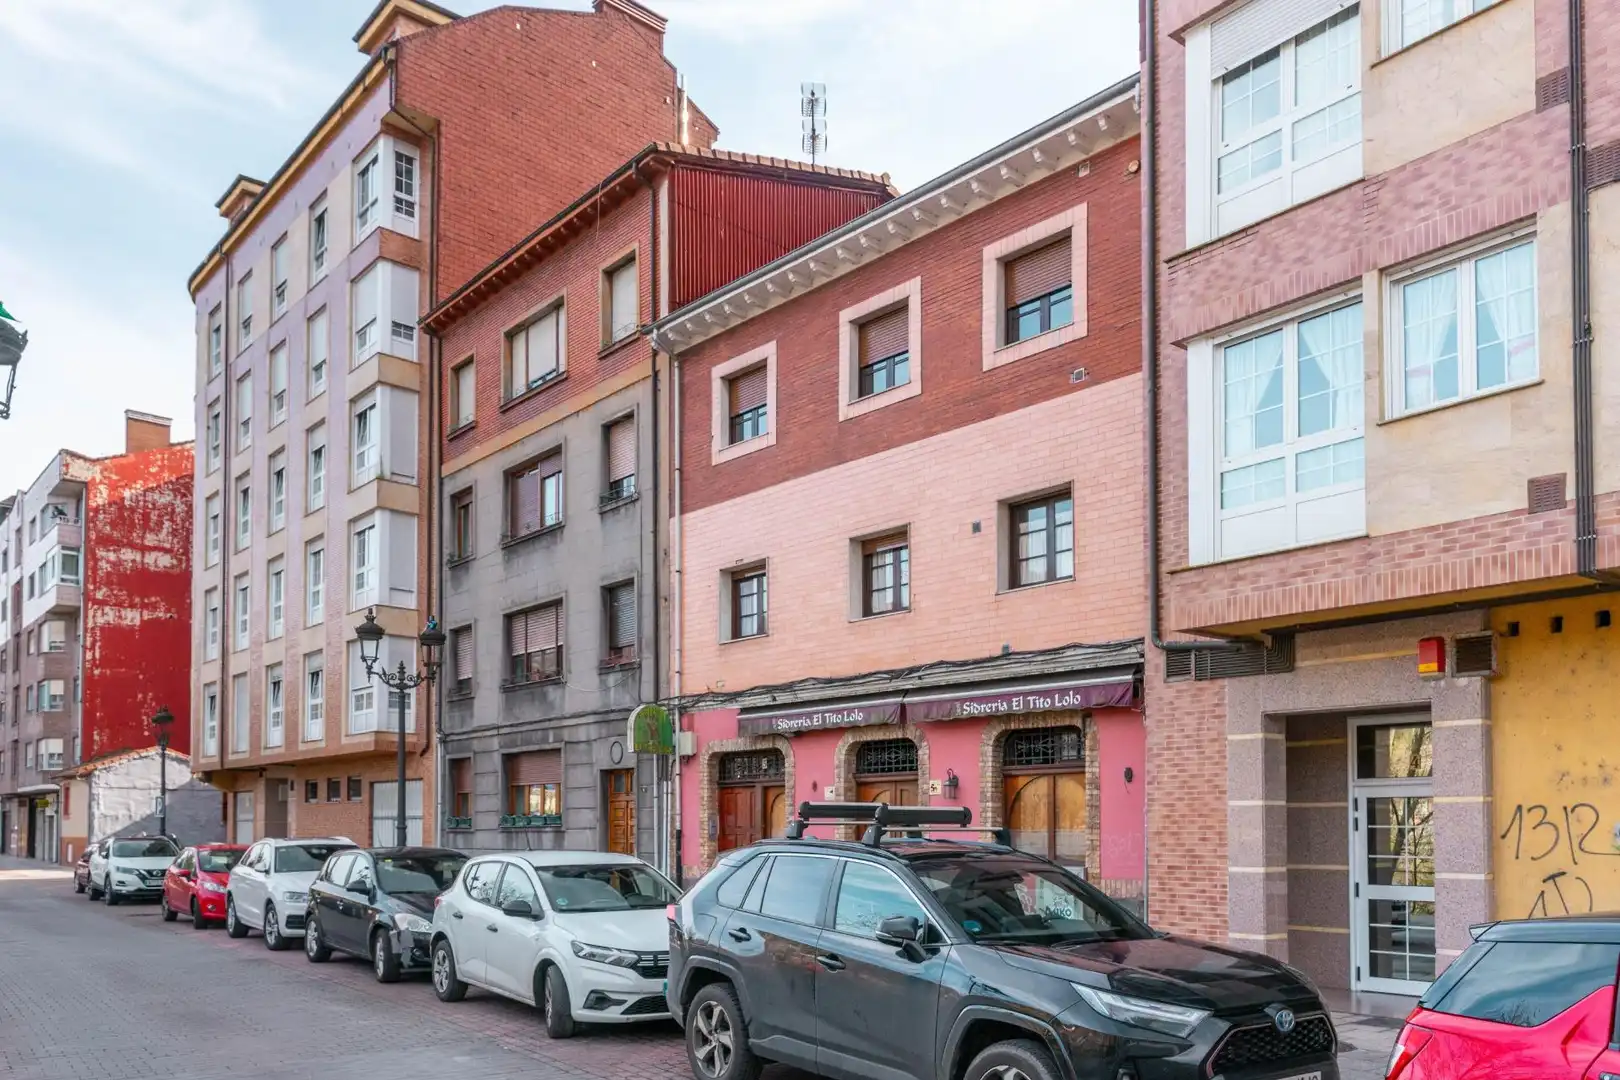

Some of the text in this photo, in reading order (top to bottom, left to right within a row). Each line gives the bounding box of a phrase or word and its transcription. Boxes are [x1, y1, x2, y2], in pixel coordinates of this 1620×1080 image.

[1012, 695, 1023, 711] El
[1026, 695, 1051, 709] Tito
[1054, 690, 1081, 707] Lolo
[813, 713, 822, 726] El
[824, 712, 842, 724] Tito
[843, 708, 864, 722] Lolo
[1500, 803, 1620, 866] 1312
